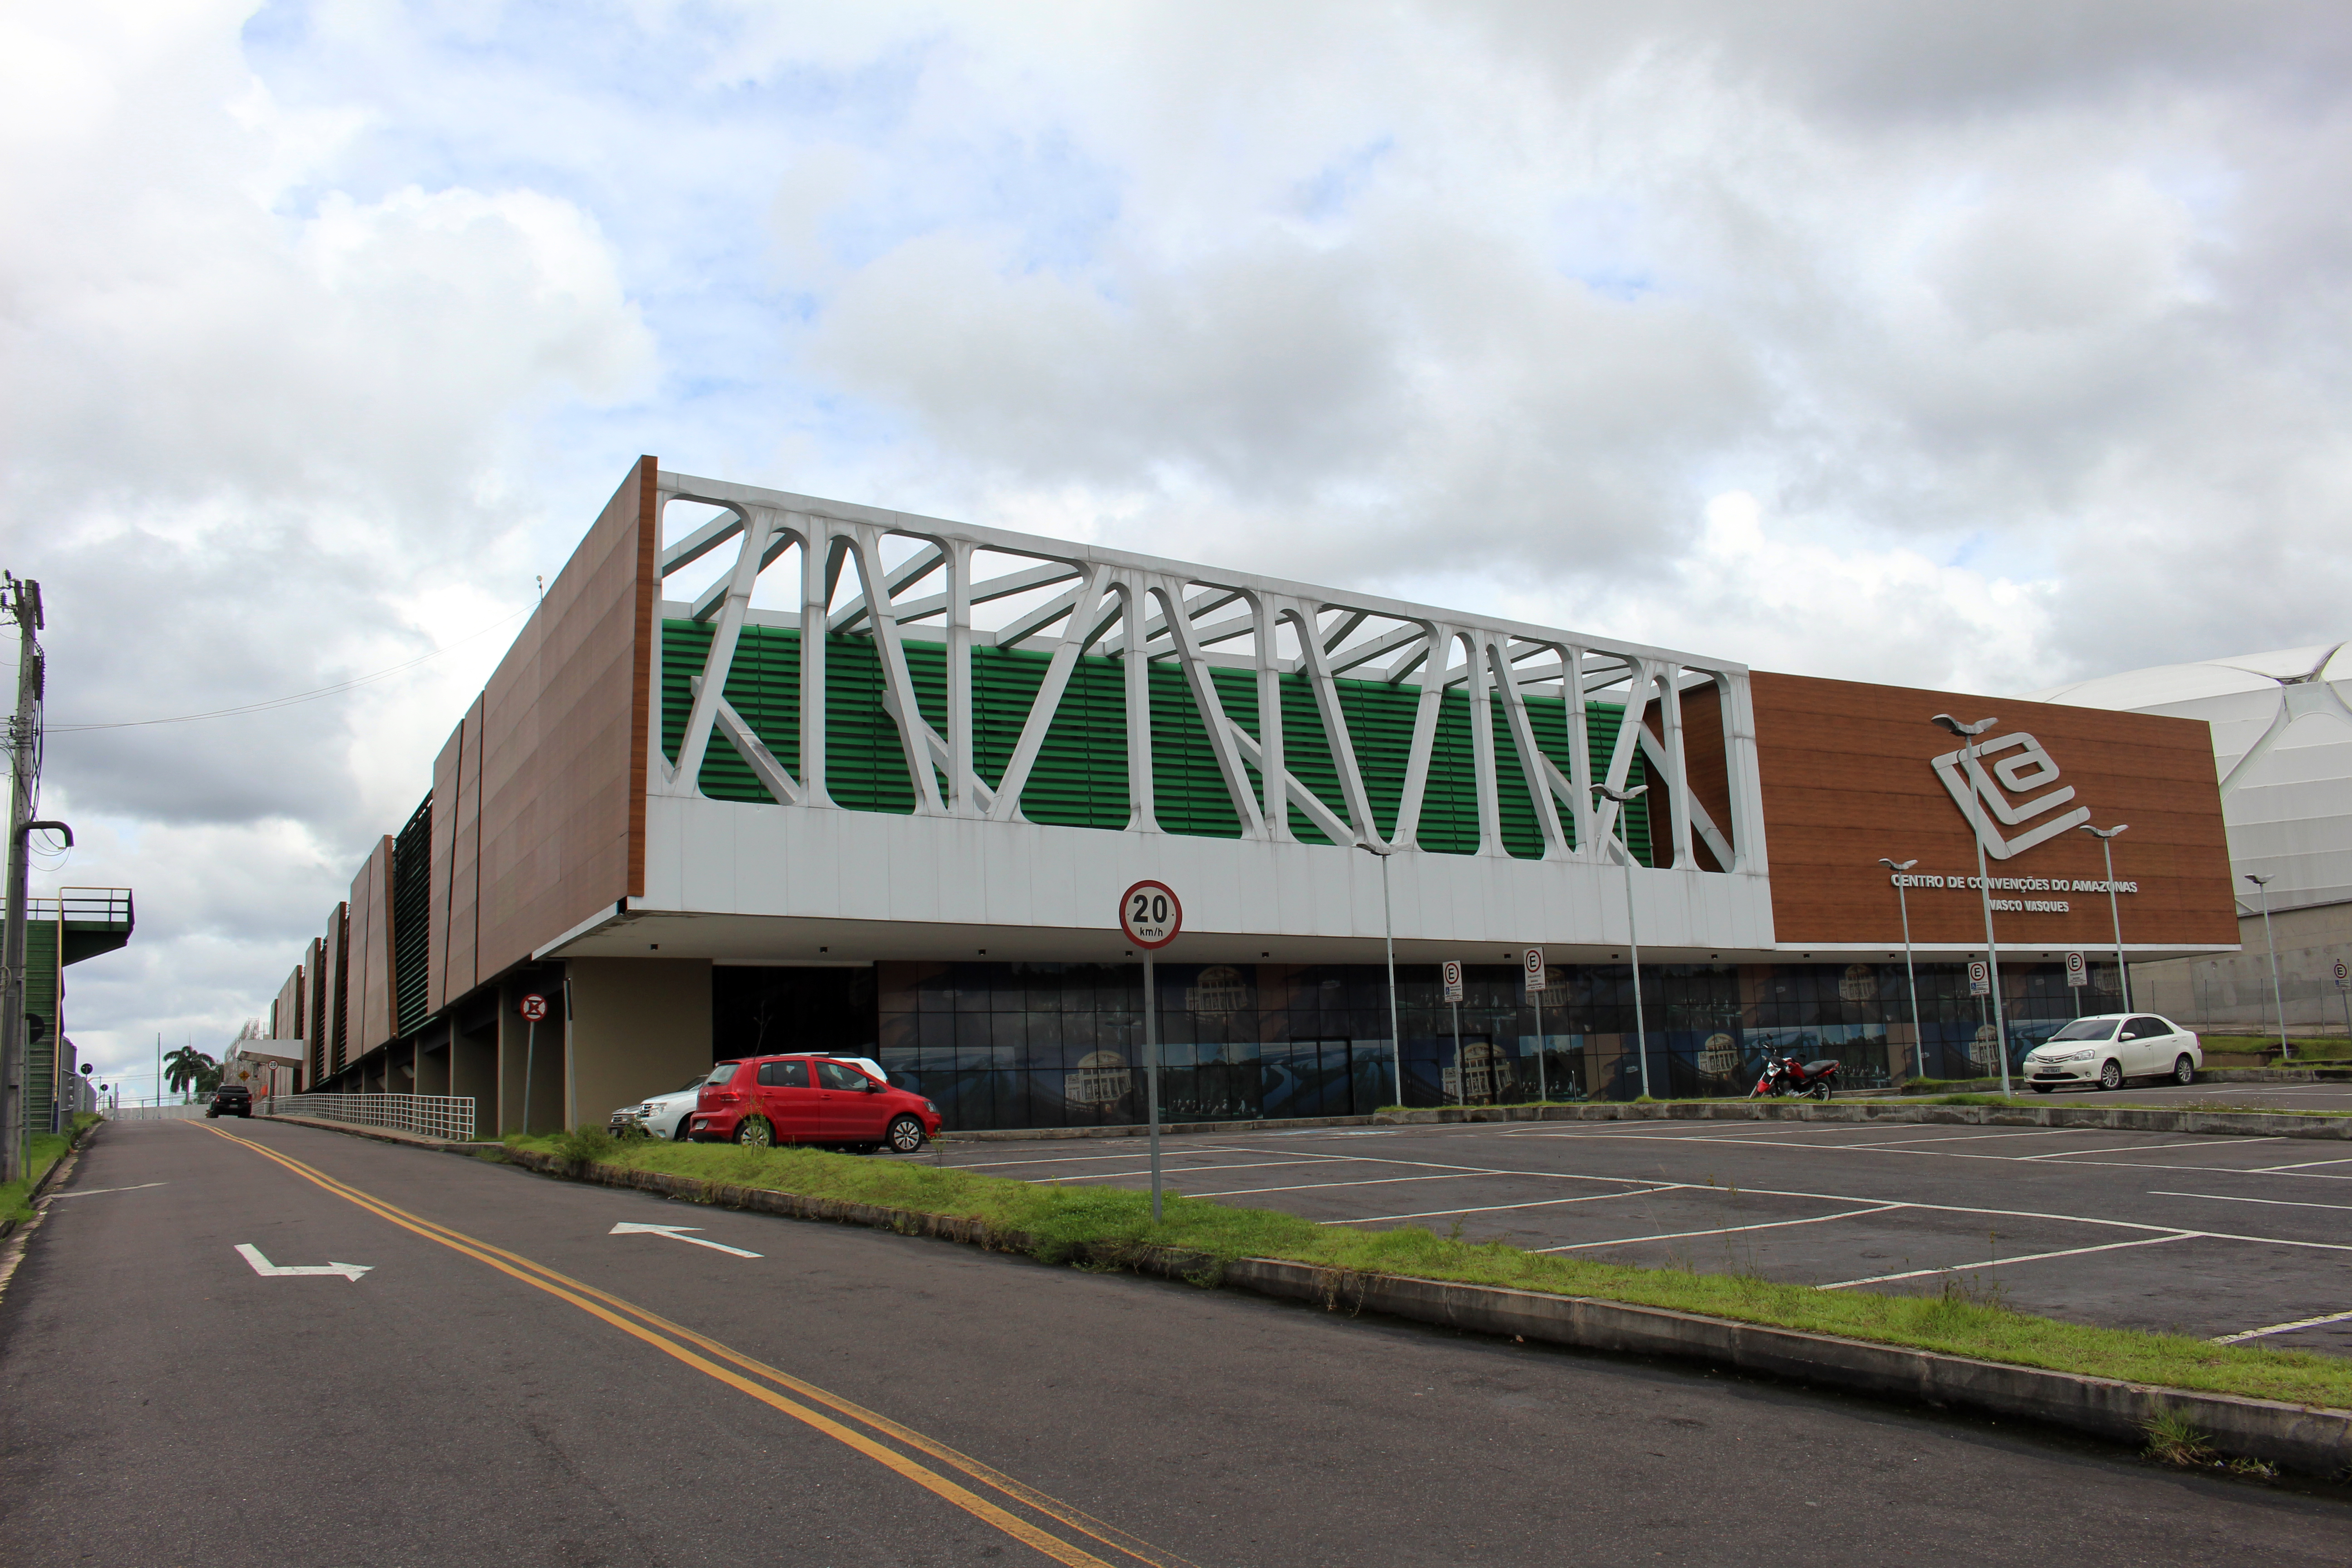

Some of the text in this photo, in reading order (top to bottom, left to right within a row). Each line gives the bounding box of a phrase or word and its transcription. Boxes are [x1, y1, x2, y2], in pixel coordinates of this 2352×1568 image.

[1891, 874, 1944, 887] CENTRO
[1946, 876, 1965, 888] DE
[1967, 876, 2049, 893] CONVENÇÕES
[2051, 879, 2069, 892] DO
[1133, 894, 1167, 923] 20
[1989, 899, 2069, 912] VASCO VASQUES
[1140, 927, 1163, 936] km/h
[1529, 955, 1536, 967] E
[2072, 957, 2078, 967] E
[1449, 968, 1455, 979] E
[1975, 967, 1981, 977] E
